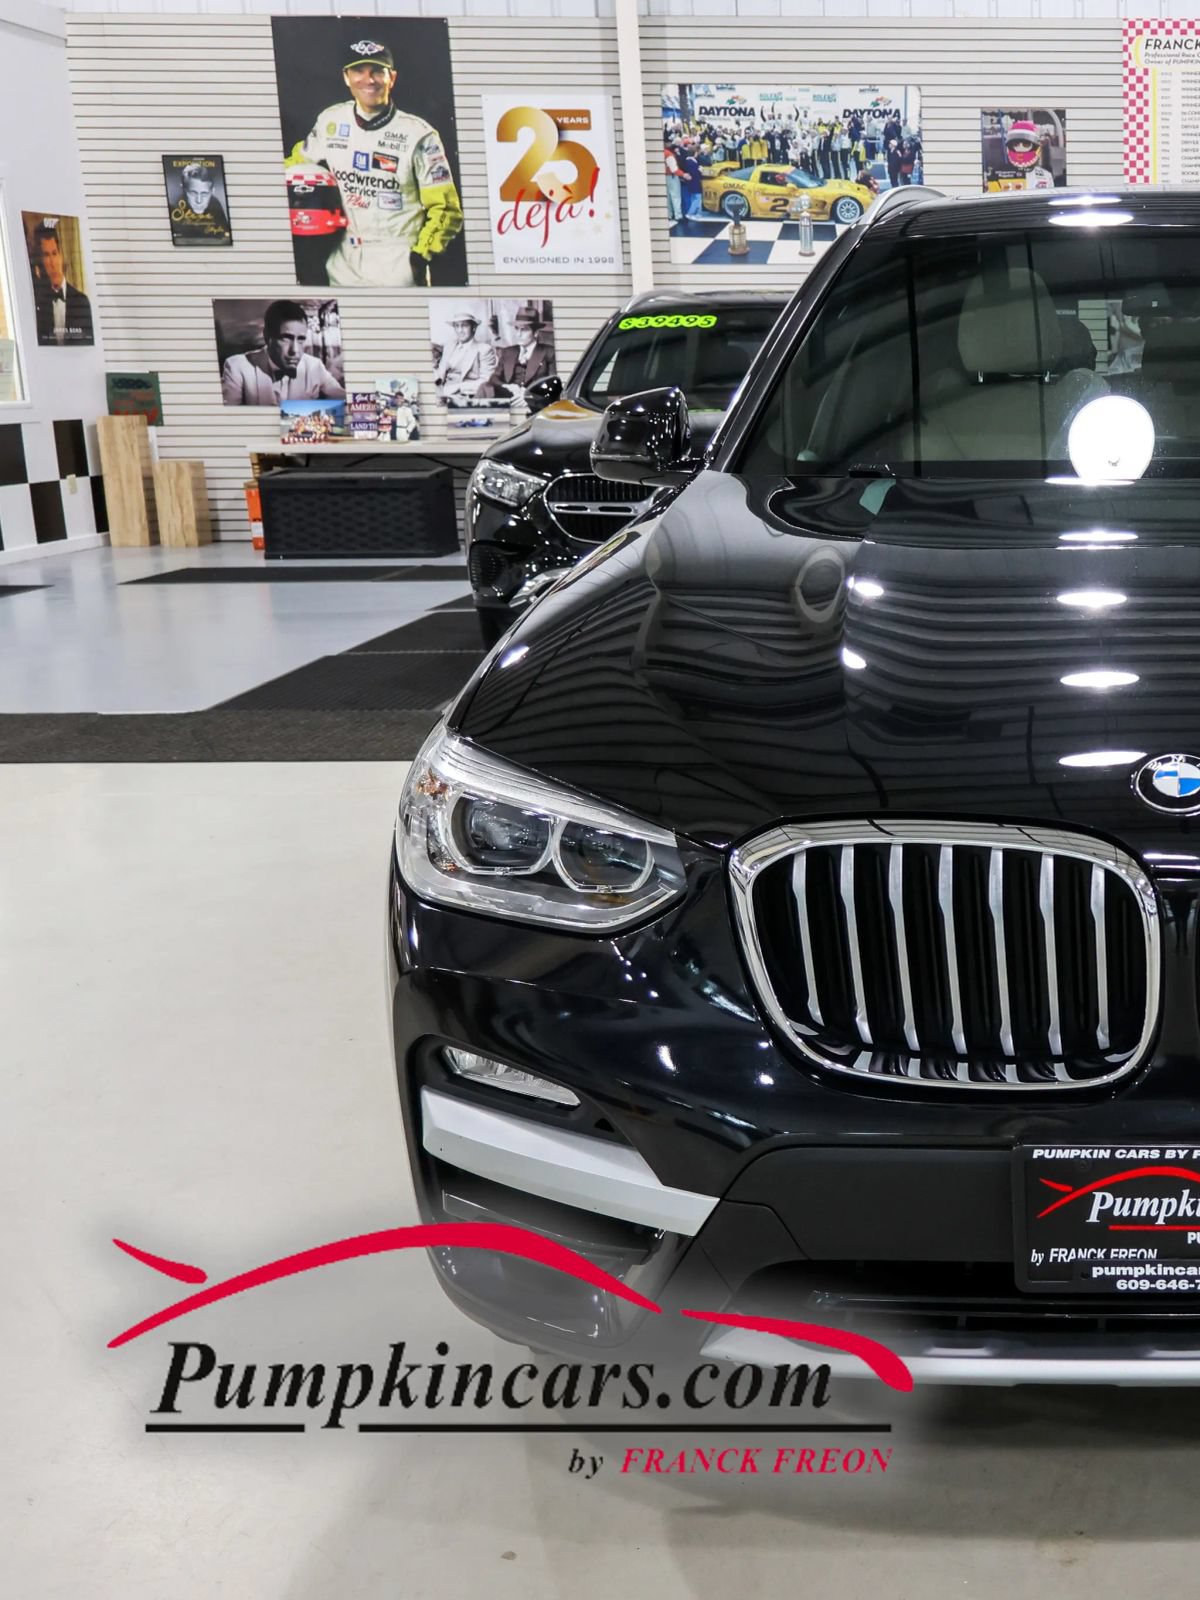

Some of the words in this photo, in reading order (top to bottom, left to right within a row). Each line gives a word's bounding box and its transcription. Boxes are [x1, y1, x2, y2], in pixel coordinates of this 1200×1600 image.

[699, 106, 756, 117] DAYTONA
[842, 108, 902, 120] DAYTONA
[497, 106, 599, 205] 25
[344, 182, 377, 198] Service
[503, 256, 569, 264] ENVISIONED
[574, 256, 584, 264] IN
[588, 256, 615, 264] 1998
[1033, 1149, 1111, 1159] PUMPKIN
[1115, 1149, 1160, 1159] CARS
[1164, 1149, 1189, 1159] BY
[1031, 1249, 1044, 1266] by
[1049, 1248, 1107, 1262] FRANCK
[1110, 1248, 1158, 1259] FREON
